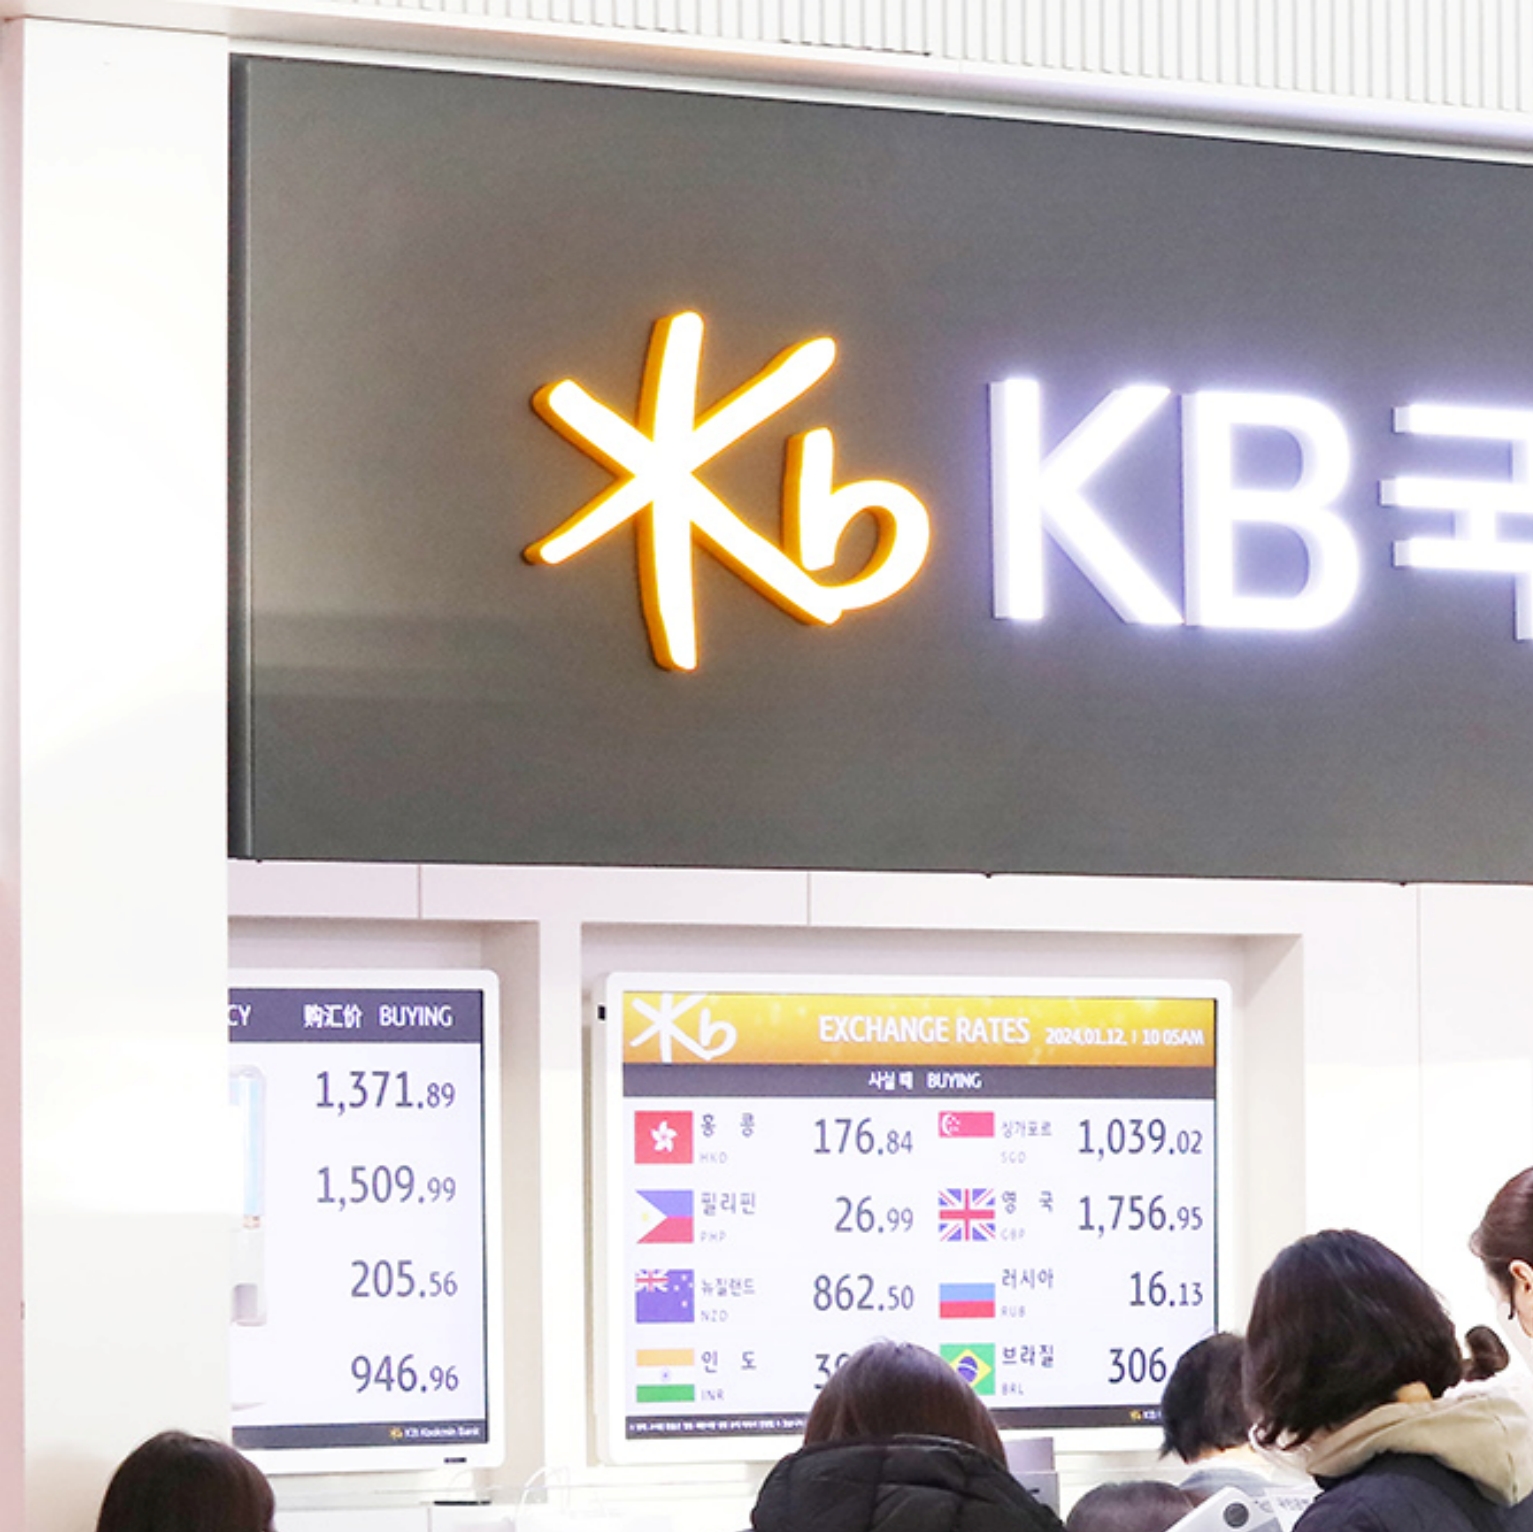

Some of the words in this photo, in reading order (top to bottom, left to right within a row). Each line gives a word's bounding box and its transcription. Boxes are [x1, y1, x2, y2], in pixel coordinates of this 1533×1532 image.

[378, 1005, 453, 1027] BUYING
[818, 1014, 950, 1043] EXCHANGE
[955, 1016, 1031, 1044] RATES
[316, 1070, 456, 1117] 1,371.89
[926, 1072, 982, 1090] BUYING
[813, 1117, 914, 1156] 176.84
[1077, 1118, 1203, 1163] 1,039.02
[700, 1152, 728, 1164] HKD
[316, 1164, 457, 1212] 1,509.99
[701, 1192, 756, 1217] 필리핀
[834, 1195, 914, 1234] 26.99
[1077, 1194, 1204, 1239] 1,756.95
[350, 1259, 459, 1298] 205.56
[813, 1273, 915, 1312] 862.50
[1002, 1268, 1054, 1290] 러시아
[1128, 1270, 1204, 1308] 16.13
[350, 1353, 460, 1394] 946.96
[1002, 1344, 1054, 1369] 브라질
